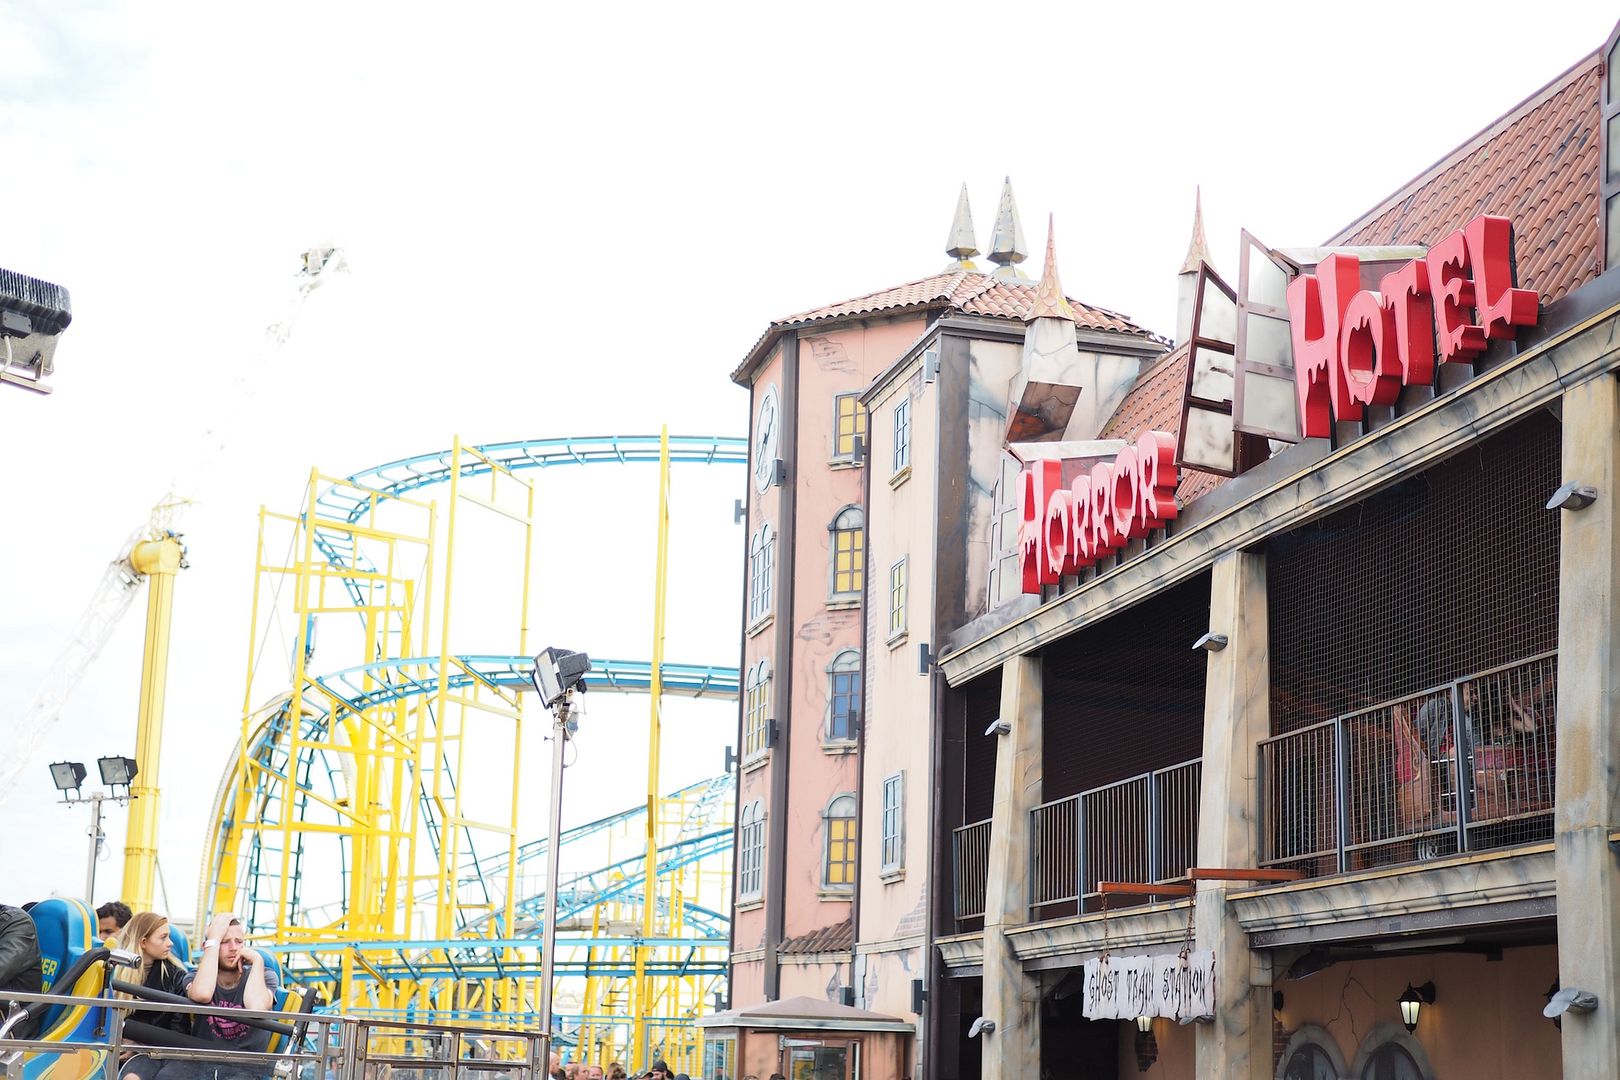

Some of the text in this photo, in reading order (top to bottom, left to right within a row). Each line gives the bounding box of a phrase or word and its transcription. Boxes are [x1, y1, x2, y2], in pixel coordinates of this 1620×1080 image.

[1016, 214, 1538, 594] HORROR HOTEL
[1088, 964, 1207, 1017] GHOST TRAIN STATION
